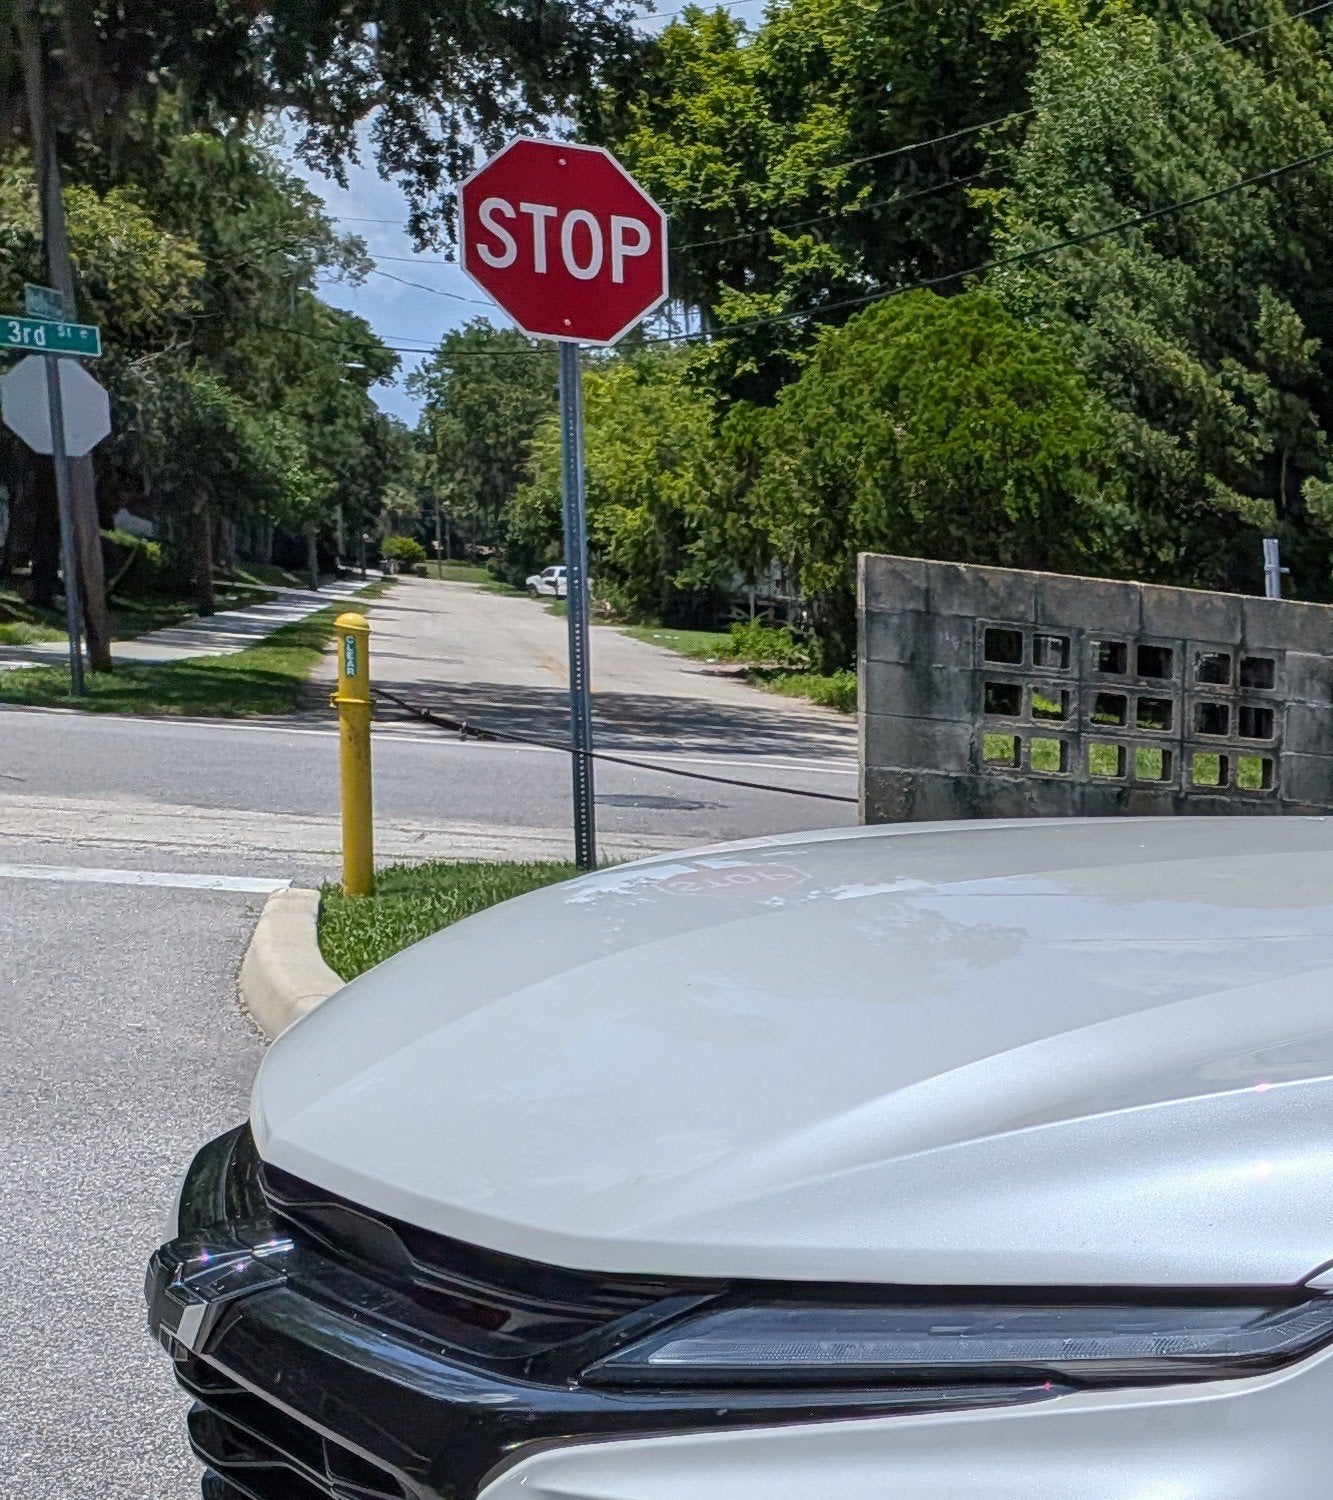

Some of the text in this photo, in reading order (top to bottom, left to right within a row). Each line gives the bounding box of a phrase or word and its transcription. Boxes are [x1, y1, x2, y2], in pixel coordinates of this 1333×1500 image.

[477, 197, 651, 284] STOP
[8, 321, 46, 346] 3rd
[345, 635, 356, 676] CLEAR
